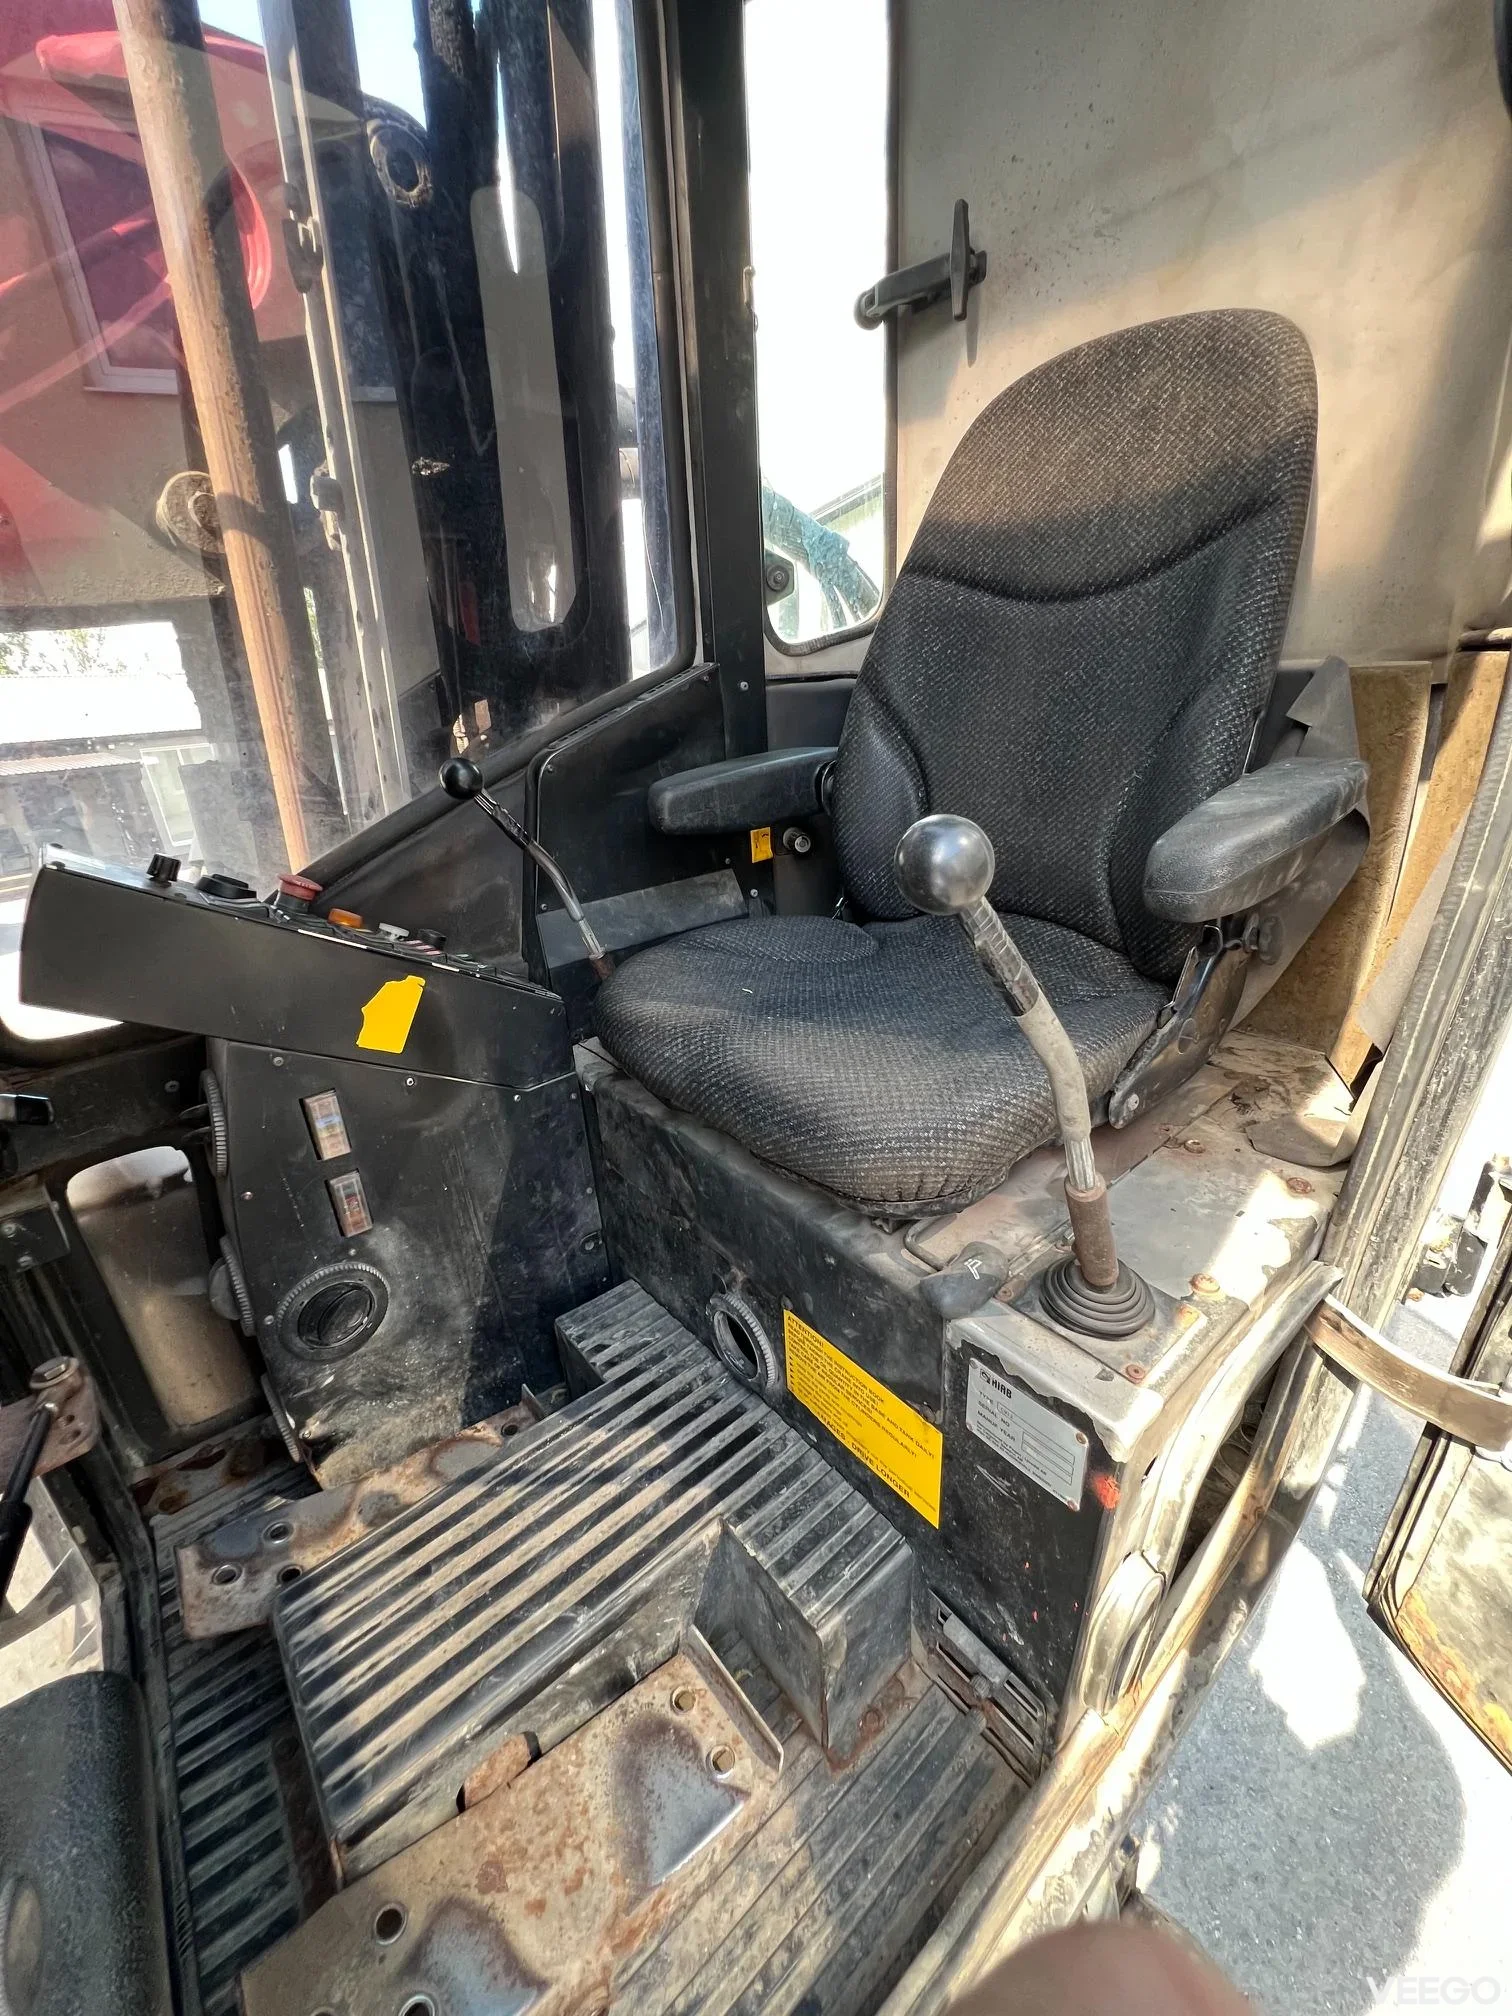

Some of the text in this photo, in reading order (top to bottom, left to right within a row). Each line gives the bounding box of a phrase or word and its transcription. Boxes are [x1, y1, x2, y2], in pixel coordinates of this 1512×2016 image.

[787, 1314, 823, 1349] ATTENTION!
[978, 1389, 994, 1405] TYPE
[991, 1376, 1012, 1400] HIAB
[1000, 1416, 1010, 1428] NO
[999, 1425, 1015, 1442] YEAR
[851, 1440, 873, 1467] DRIVE
[875, 1462, 910, 1500] LONGER
